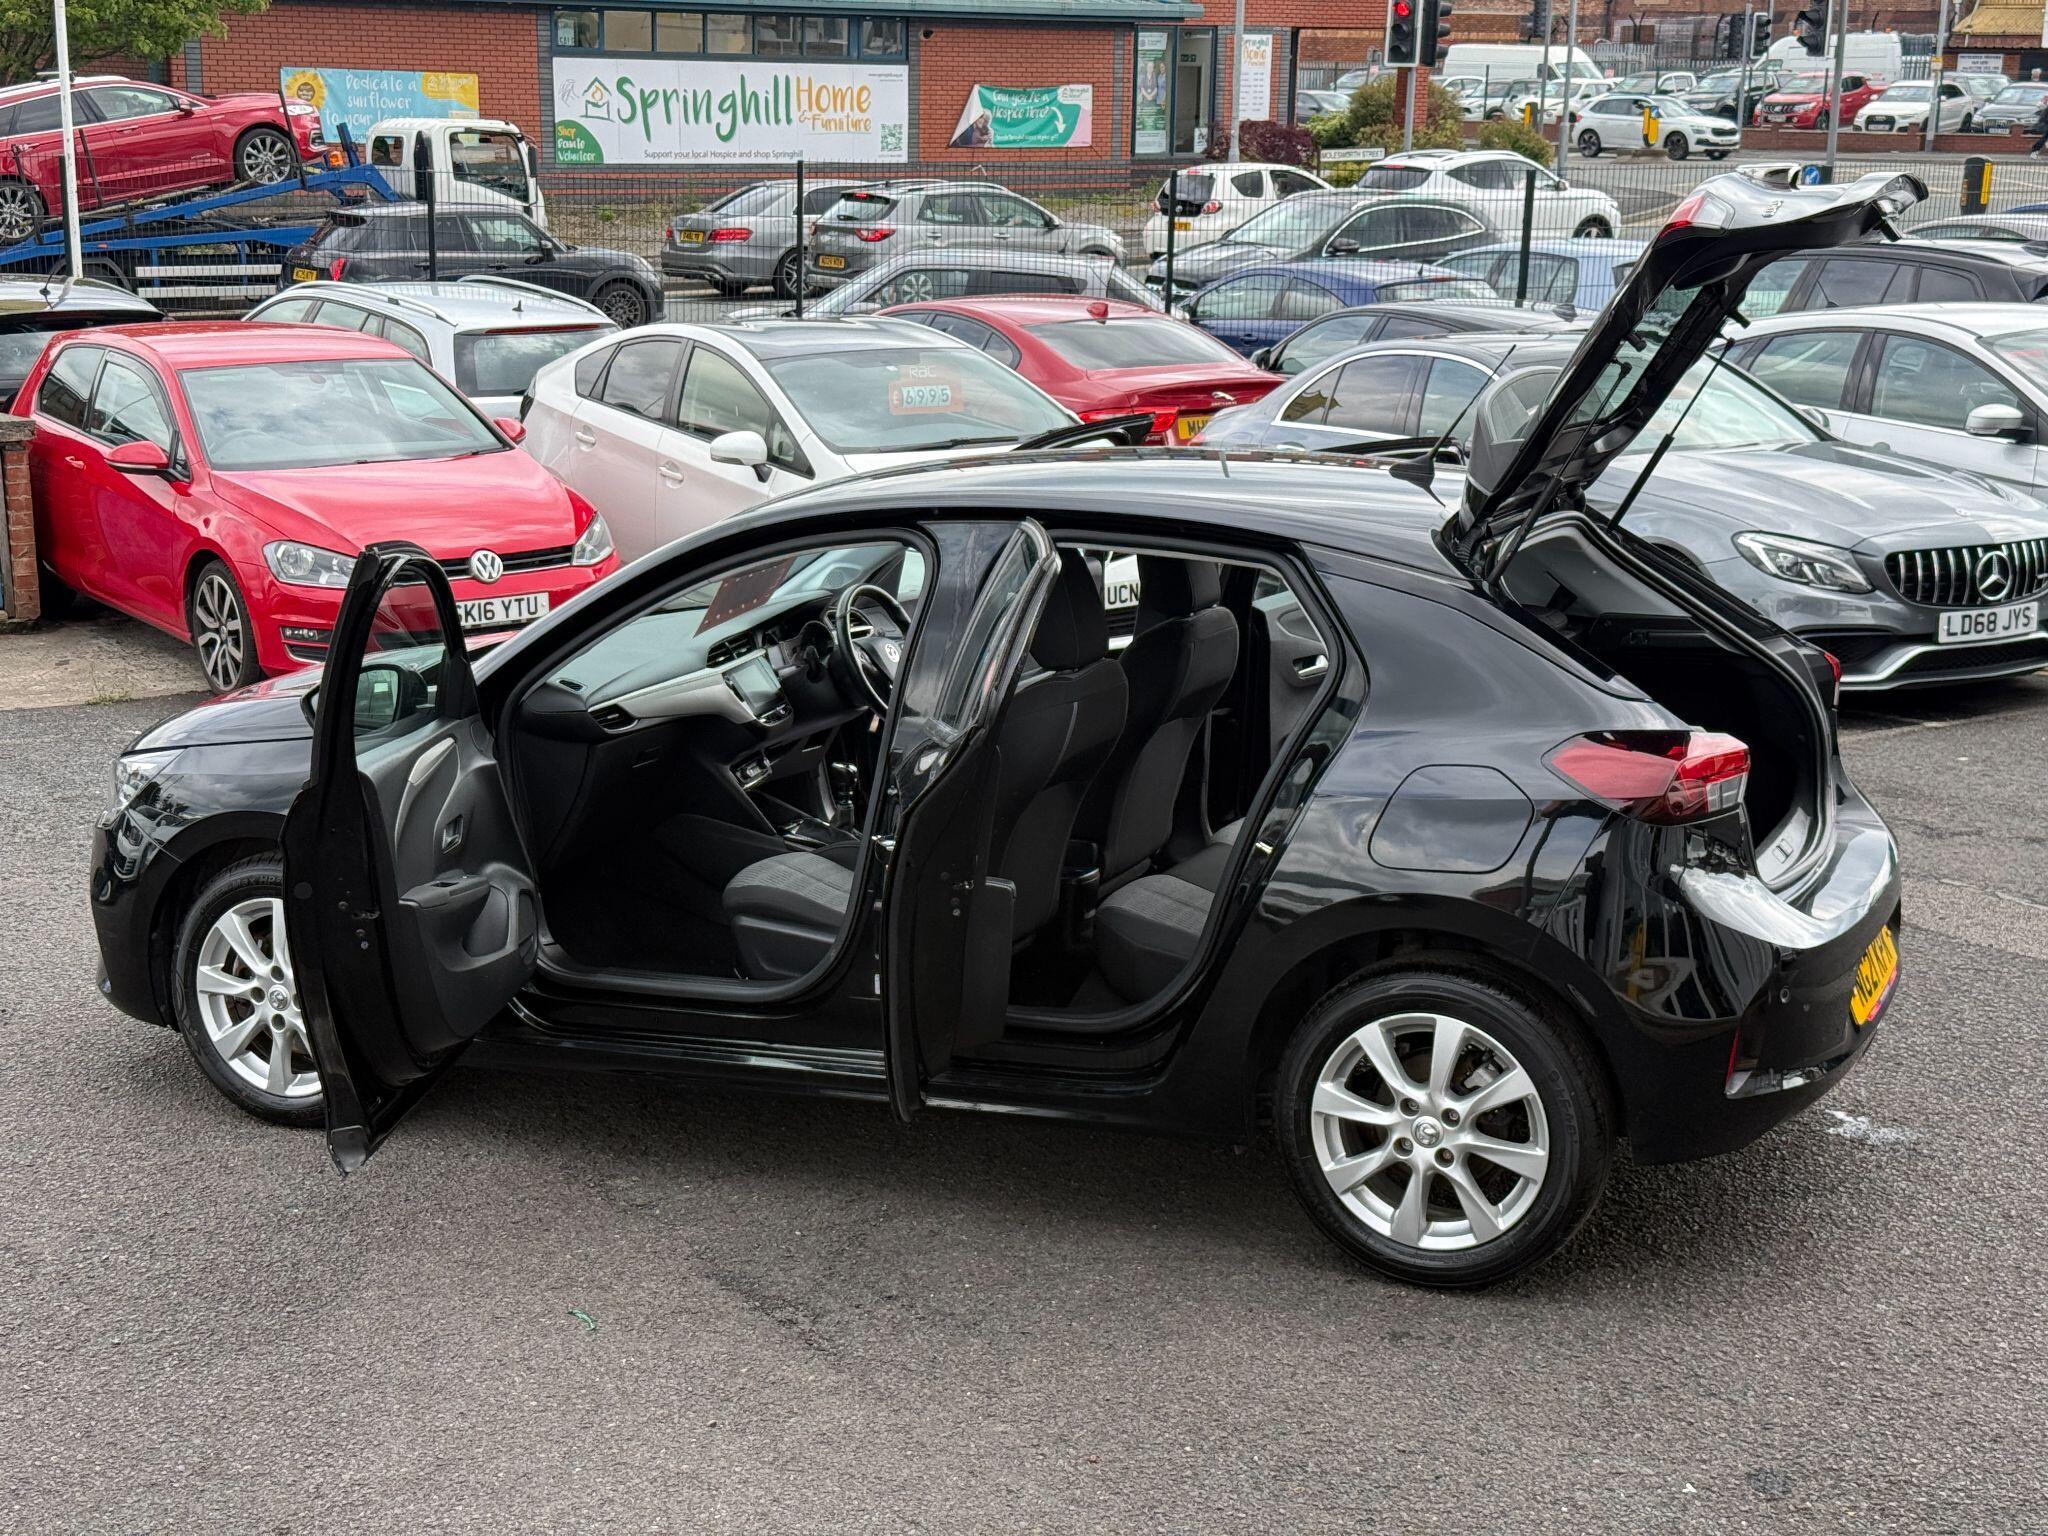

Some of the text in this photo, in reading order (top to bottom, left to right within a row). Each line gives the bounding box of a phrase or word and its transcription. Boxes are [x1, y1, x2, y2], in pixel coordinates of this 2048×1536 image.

[345, 74, 403, 92] Dedicate
[408, 79, 417, 92] a
[346, 92, 412, 109] sunflower
[616, 74, 871, 143] Springhill Home
[323, 108, 340, 126] to
[344, 112, 373, 130] your
[798, 109, 872, 132] & Furniture
[557, 125, 576, 139] Shop
[557, 150, 596, 162] Volunteer
[644, 149, 803, 160] Support your local Hospice and shop Springhill
[905, 388, 949, 405] 6995
[1107, 583, 1139, 605] UCN
[501, 595, 538, 619] YTU
[1946, 606, 2031, 637] LD68 JYS
